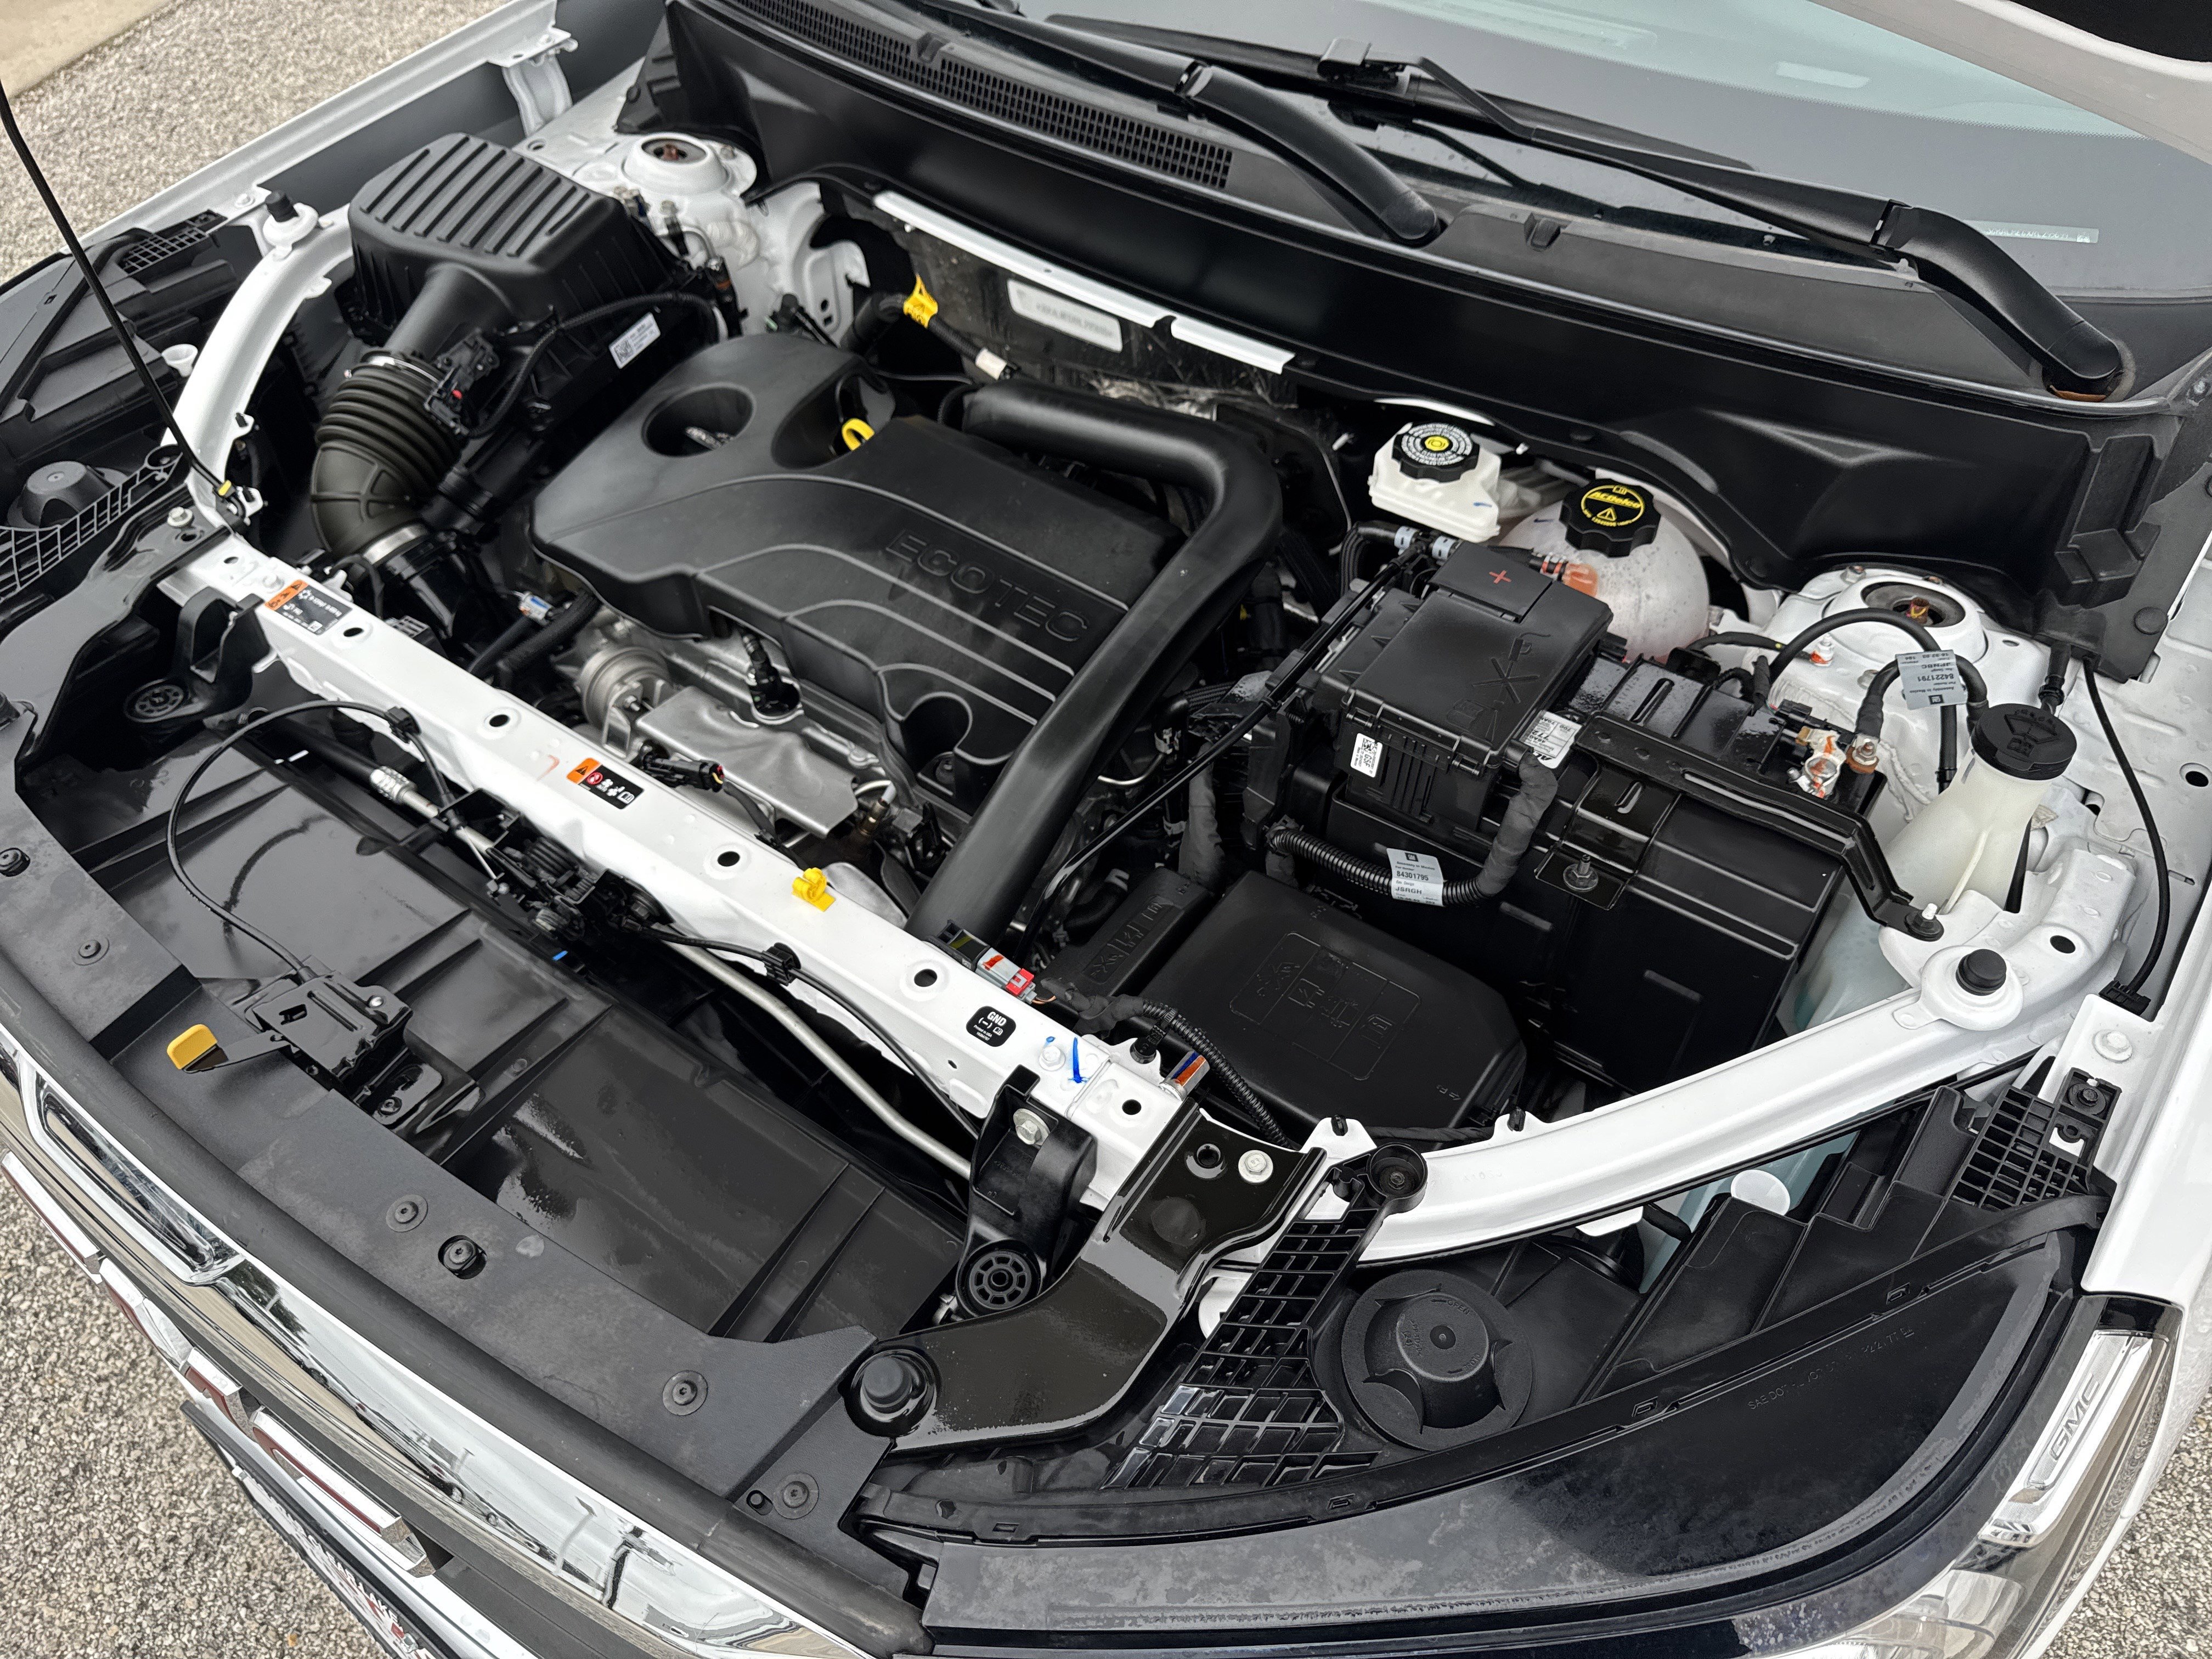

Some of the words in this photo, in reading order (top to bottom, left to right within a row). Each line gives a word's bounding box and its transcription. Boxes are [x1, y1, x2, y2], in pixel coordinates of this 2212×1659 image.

[1587, 491, 1641, 509] ACDelco
[885, 526, 1089, 642] ECOTEC
[1396, 871, 1429, 881] 84301795
[987, 1011, 1007, 1026] GND
[1447, 1300, 1472, 1315] OPEN
[1747, 1395, 1769, 1410] SAE
[2049, 1373, 2100, 1461] GMC
[357, 1582, 399, 1626] LAKE
